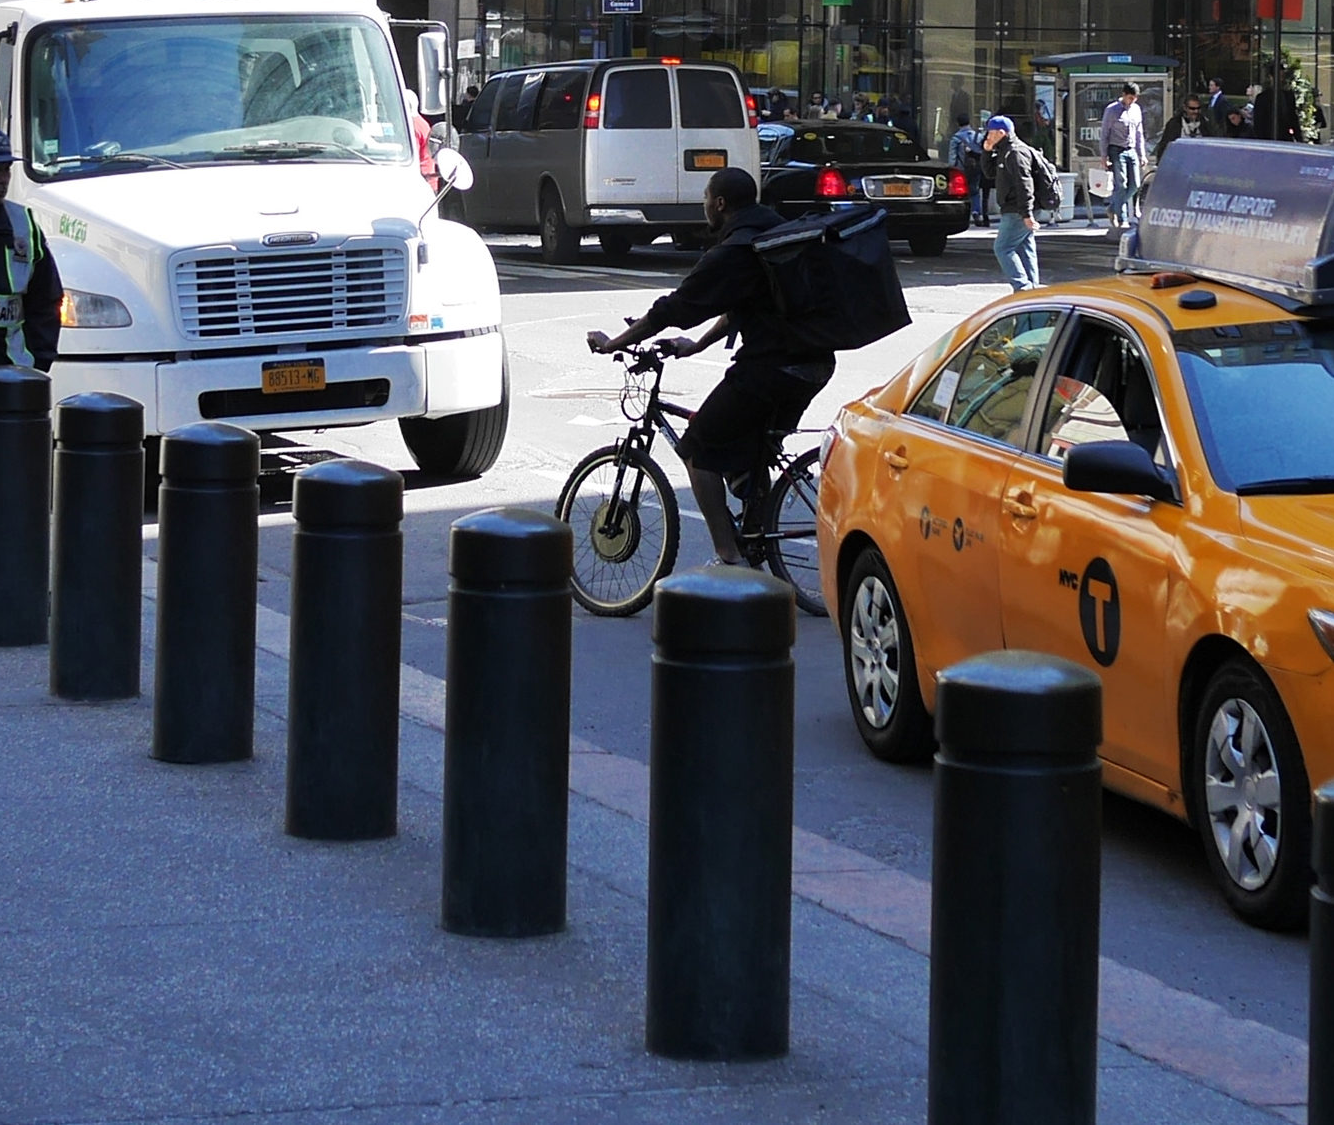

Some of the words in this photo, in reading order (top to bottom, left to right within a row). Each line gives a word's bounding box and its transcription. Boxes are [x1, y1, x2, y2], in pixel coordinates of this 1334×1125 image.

[935, 173, 947, 190] 6
[1299, 166, 1330, 177] UNITED
[1186, 190, 1229, 212] NEWARK
[1228, 194, 1277, 218] AIRPORT:
[58, 214, 88, 244] Bk120
[1149, 207, 1182, 228] CLOSER
[1182, 210, 1196, 229] TO
[1194, 212, 1258, 237] MANHATTAN
[1258, 220, 1285, 241] THAN
[1284, 224, 1310, 246] JFK
[1058, 568, 1079, 590] NYC
